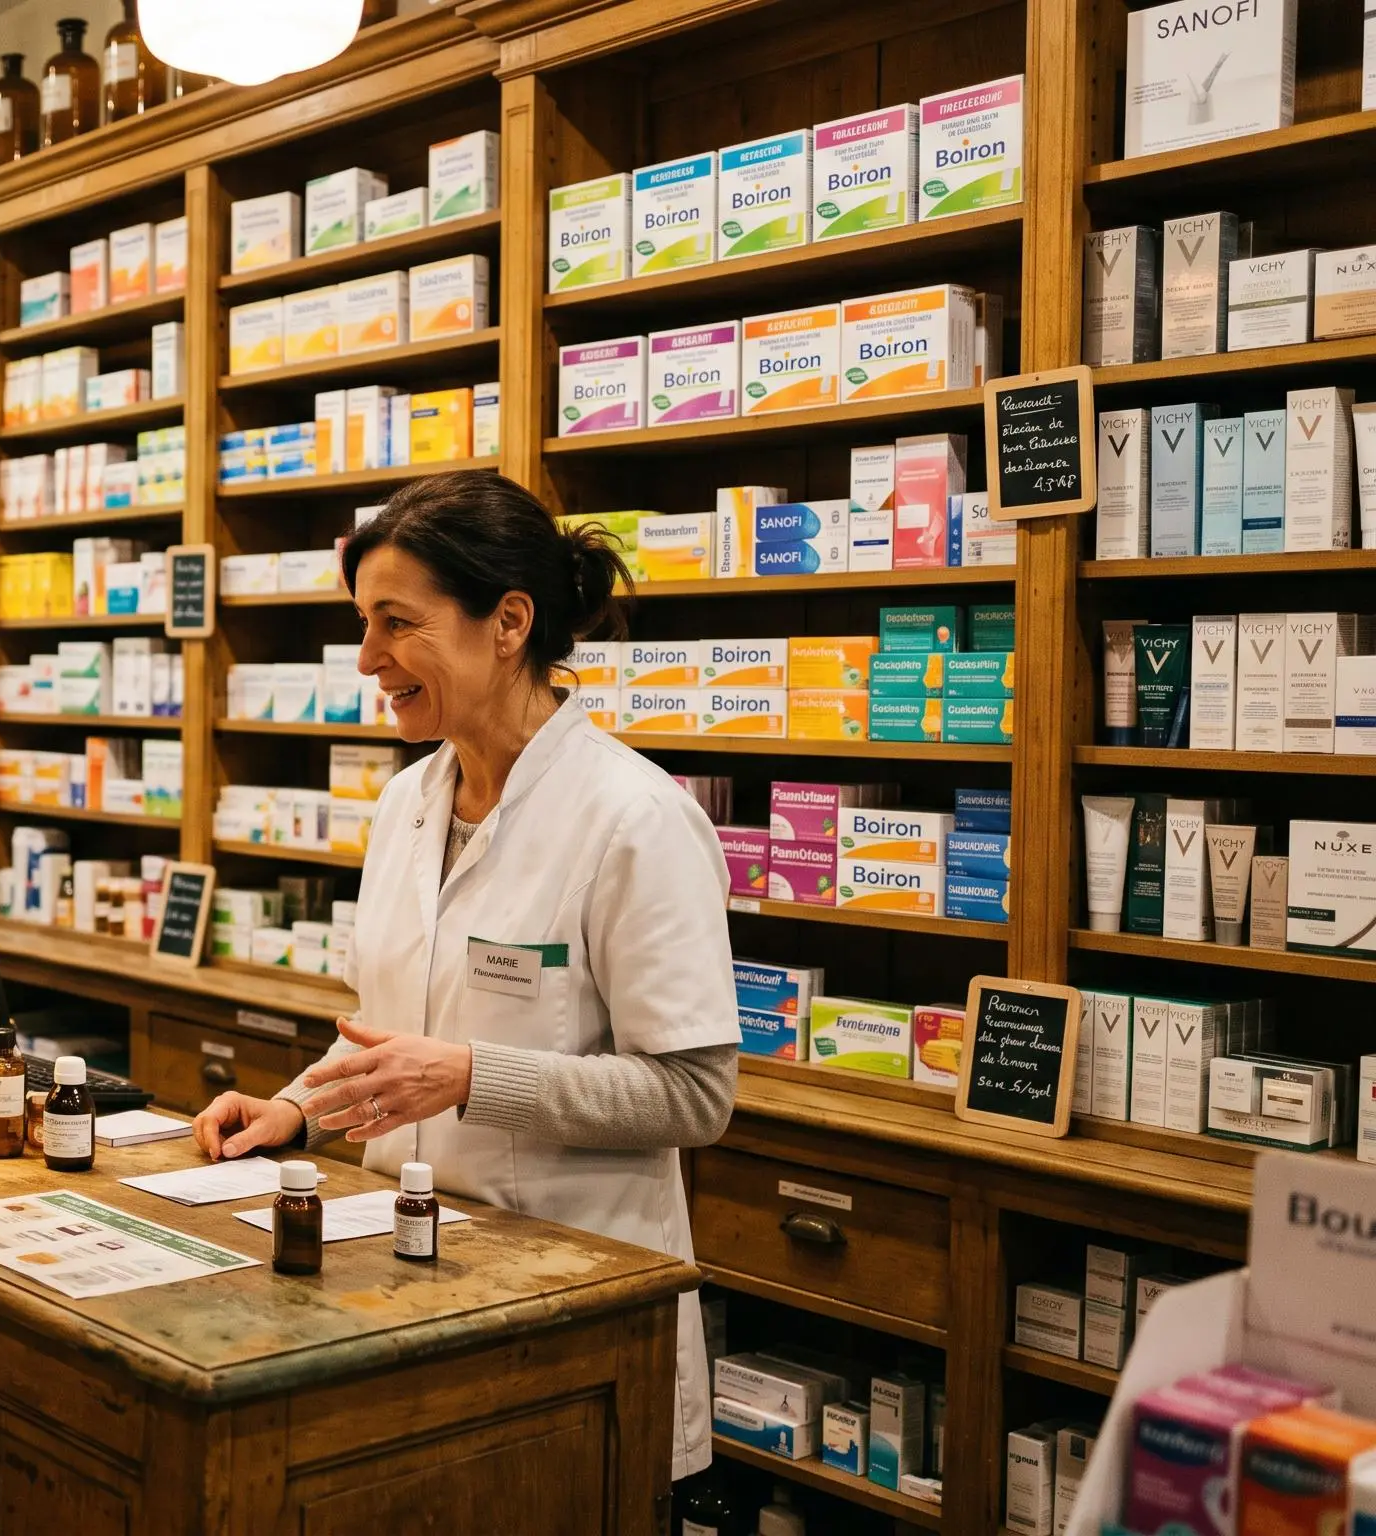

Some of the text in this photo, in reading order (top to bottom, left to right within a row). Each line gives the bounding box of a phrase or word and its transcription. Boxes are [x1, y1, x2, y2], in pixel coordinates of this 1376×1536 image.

[1157, 0, 1257, 39] SANOFI
[936, 139, 1005, 169] Boiron
[828, 164, 892, 191] Boiron
[732, 183, 791, 209] Boiron
[645, 205, 700, 229] Boiron
[1168, 218, 1215, 235] VICHY
[561, 225, 611, 247] Boiron
[1088, 232, 1133, 247] VICHY
[1249, 260, 1286, 274] VICHY
[860, 336, 928, 360] Boiron
[759, 351, 821, 375] Boiron
[664, 367, 721, 388] Boiron
[574, 378, 626, 400] Boiron
[1290, 398, 1332, 411] VICHY
[1101, 417, 1138, 430] VICHY
[1153, 412, 1193, 425] VICHY
[1248, 417, 1283, 428] VICHY
[1207, 424, 1241, 434] VICHY
[760, 516, 802, 529] SANOFI
[759, 552, 802, 564] SANOFI
[1195, 624, 1233, 636] VICHY
[1242, 623, 1285, 635] VICHY
[1290, 623, 1334, 635] VICHY
[1141, 638, 1180, 648] VICHY
[633, 648, 687, 664] Boiron
[712, 647, 771, 663] Boiron
[631, 694, 686, 710] Boiron
[711, 695, 771, 712] Boiron
[853, 815, 921, 838] Boiron
[1169, 819, 1200, 829] VICHY
[1212, 837, 1246, 849] VICHY
[1314, 840, 1372, 854] NUXE
[853, 865, 921, 888] Boiron
[486, 954, 519, 968] MARIE
[1096, 1000, 1126, 1011] VICHY
[1136, 1005, 1167, 1016] VICHY
[1170, 1010, 1201, 1022] VICHY
[1288, 1190, 1376, 1239] Bou
